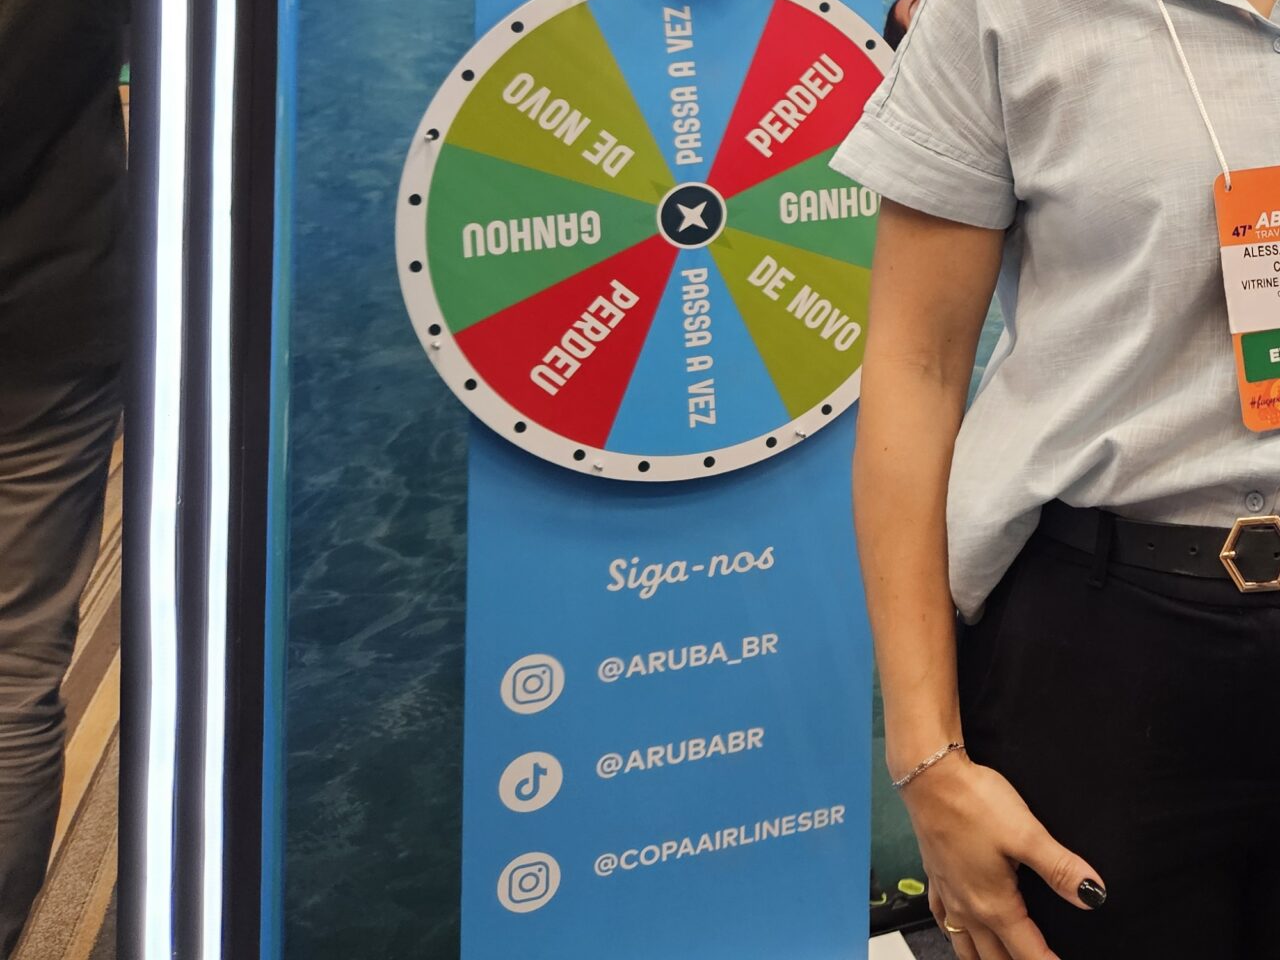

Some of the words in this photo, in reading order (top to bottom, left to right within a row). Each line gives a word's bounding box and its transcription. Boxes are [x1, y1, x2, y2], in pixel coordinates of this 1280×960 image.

[663, 5, 693, 53] VEZ
[669, 61, 696, 77] A
[502, 72, 592, 146] NOVO
[670, 85, 703, 166] PASSA
[744, 53, 845, 159] PERDEU
[582, 129, 635, 178] DE
[462, 210, 602, 258] GANHOU
[681, 268, 713, 348] PASSA
[746, 255, 795, 301] DE
[786, 284, 862, 352] NOVO
[1241, 278, 1279, 290] VITRINE
[529, 279, 640, 396] PERDEU
[686, 355, 714, 372] A
[688, 378, 717, 428] VEZ
[606, 546, 776, 600] Siga-nos
[597, 633, 779, 683] @ARUBA_BR
[595, 727, 765, 779] @ARUBABR
[593, 805, 846, 877] @COPAAIRLINESBR
